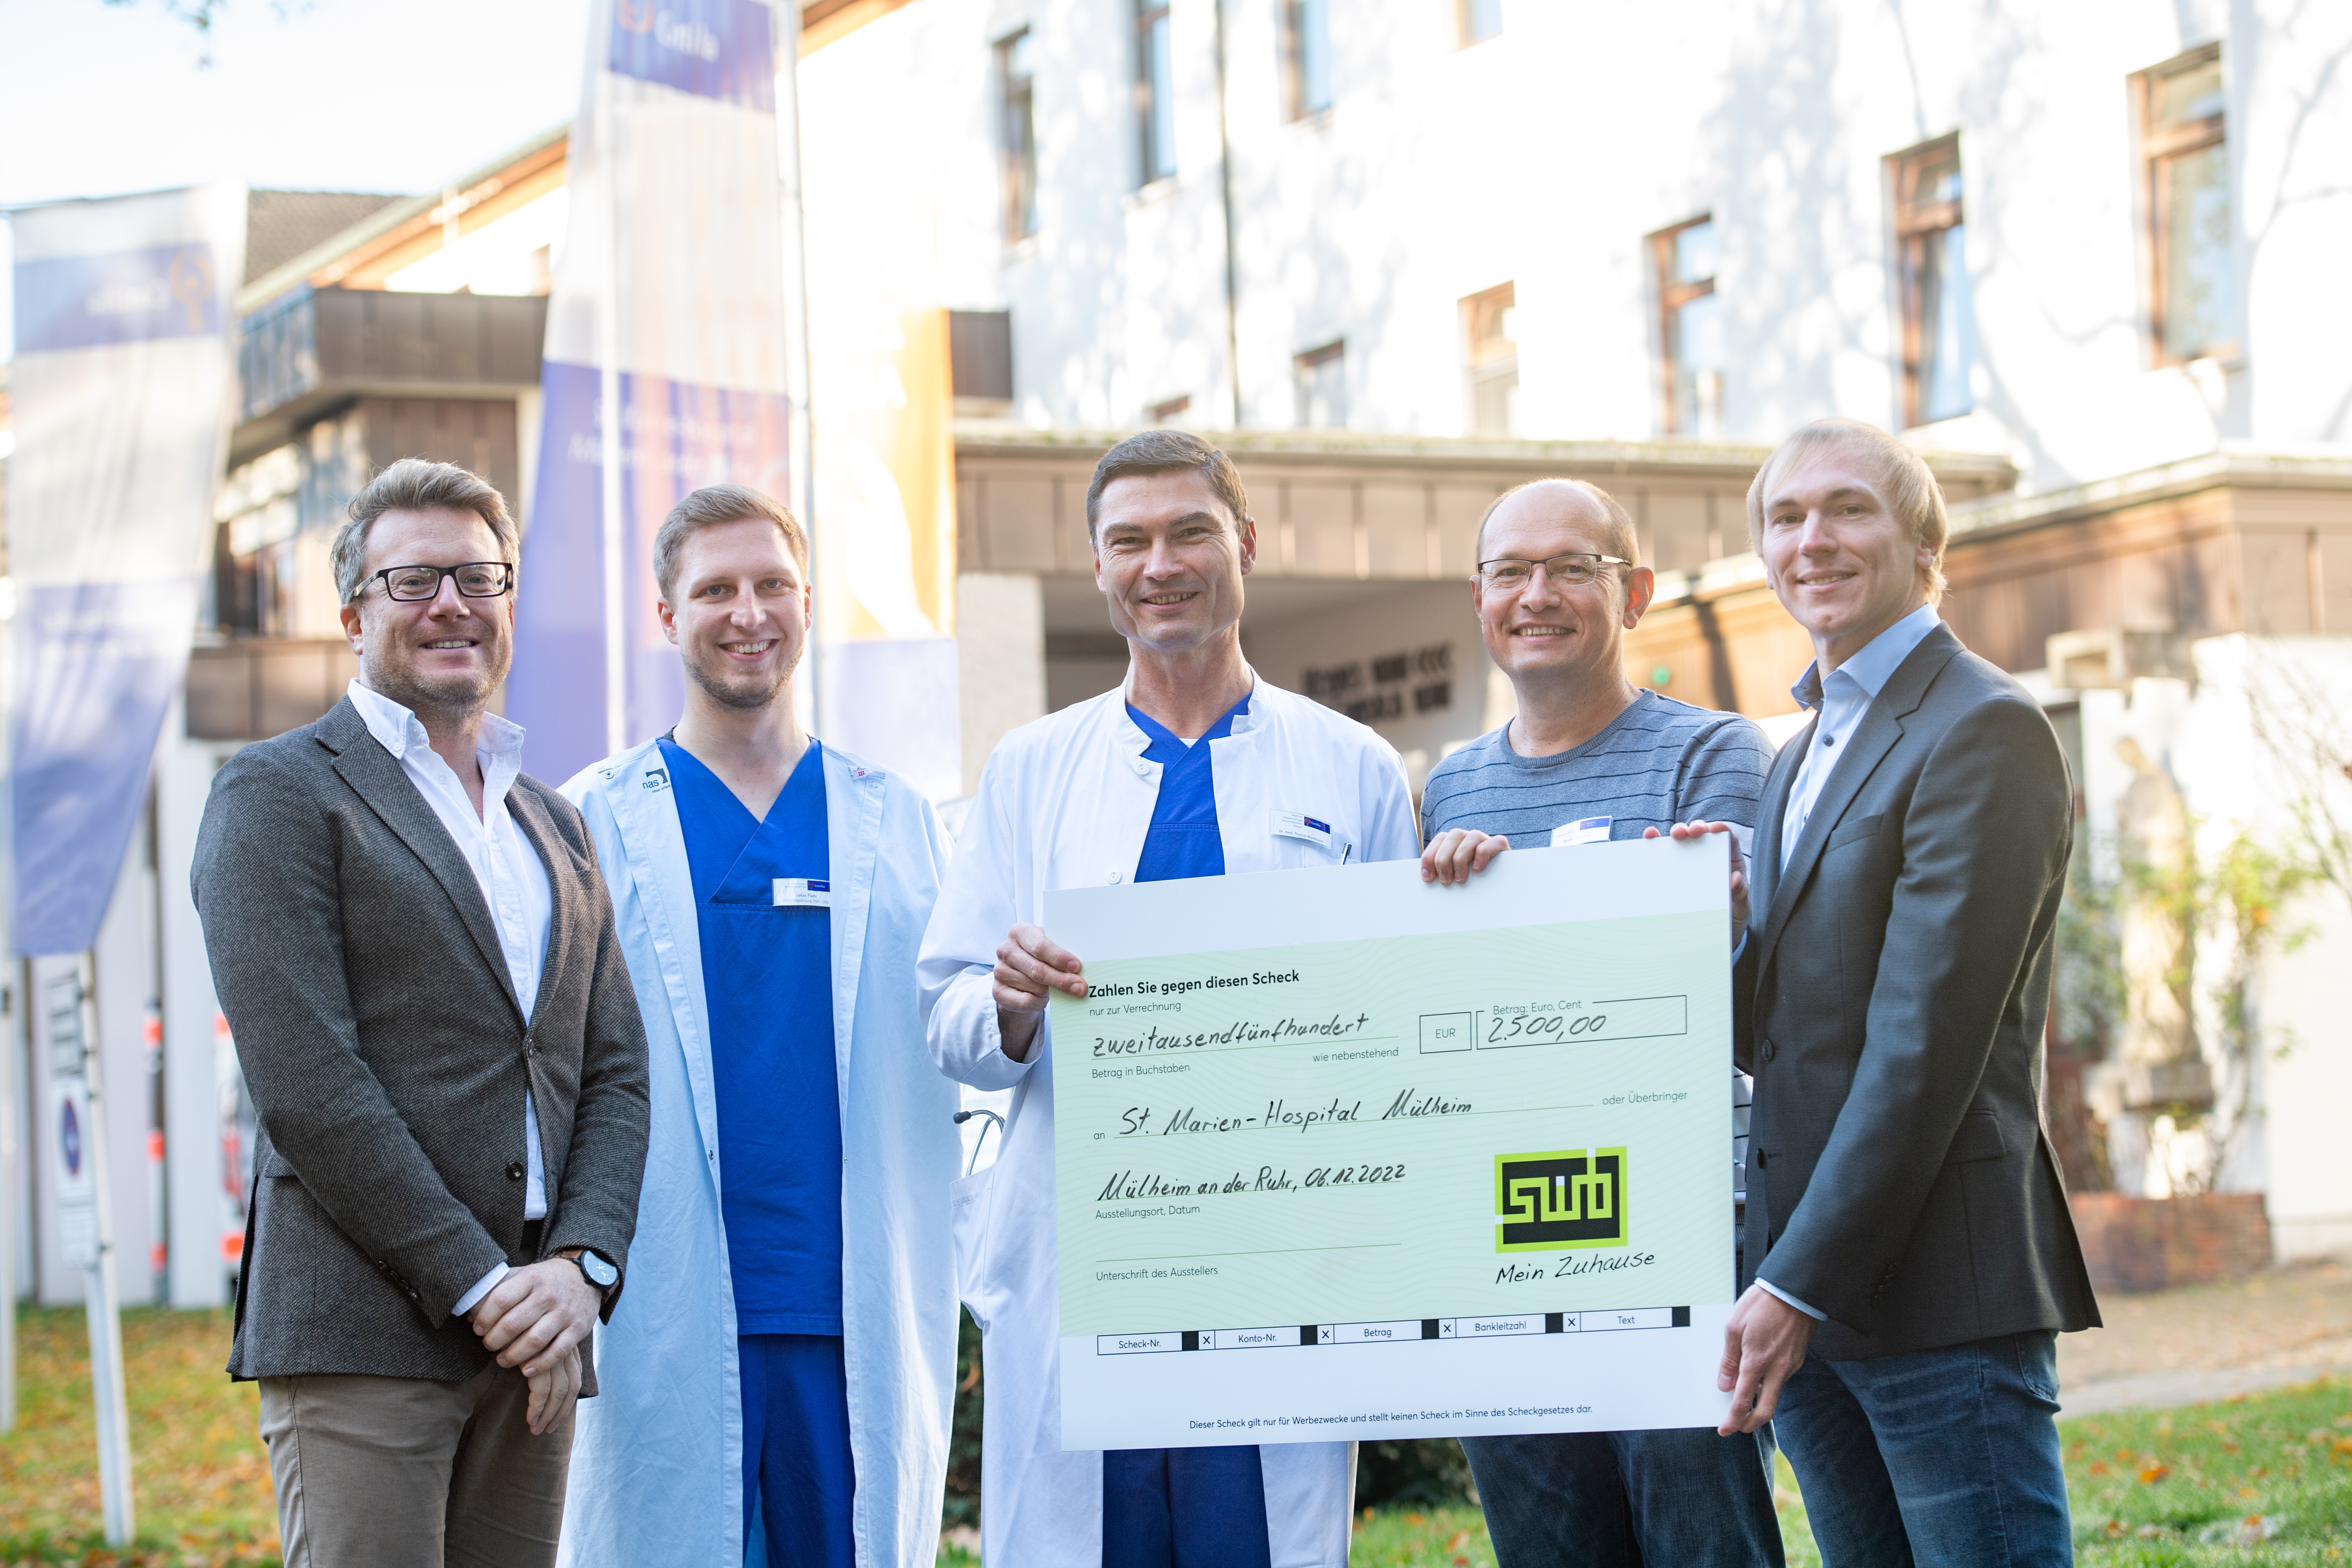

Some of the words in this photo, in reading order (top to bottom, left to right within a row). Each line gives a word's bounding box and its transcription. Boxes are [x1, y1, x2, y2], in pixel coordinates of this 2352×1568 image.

[642, 780, 659, 789] nas
[1089, 983, 1133, 998] Zahlen
[1138, 981, 1157, 994] Sie
[1161, 981, 1201, 995] gegen
[1206, 976, 1248, 988] diesen
[1252, 969, 1299, 985] Scheck
[1123, 1002, 1181, 1013] Verrechnung
[1493, 1005, 1528, 1015] Betrag:
[1531, 1002, 1555, 1012] Euro,
[1558, 1000, 1582, 1010] Cent
[1093, 1013, 1368, 1057] zweitausendfünfhundert
[1436, 1028, 1456, 1039] EUR
[1488, 1015, 1606, 1043] 2.500,00
[1332, 1047, 1398, 1061] nebenstehend
[1092, 1069, 1122, 1079] Betrag
[1125, 1067, 1133, 1076] in
[1136, 1063, 1190, 1075] Buchstaben
[1602, 1095, 1625, 1105] oder
[1628, 1091, 1688, 1103] Überbringer
[1120, 1108, 1150, 1134] St.
[1382, 1088, 1471, 1119] Mülheim
[1097, 1170, 1190, 1200] Mülheim
[1198, 1183, 1220, 1194] an
[1223, 1172, 1250, 1193] der
[1254, 1166, 1297, 1192] Ruhr,
[1305, 1165, 1405, 1187] 06.12.2022
[1095, 1207, 1165, 1219] Ausstellungsort,
[1169, 1205, 1200, 1215] Datum
[1096, 1269, 1149, 1281] Unterschrift
[1152, 1268, 1167, 1278] des
[1170, 1266, 1218, 1277] Ausstellers
[1495, 1263, 1544, 1285] Mein
[1554, 1252, 1655, 1278] Zuhause
[1475, 1321, 1526, 1331] Bankleitzahl
[1617, 1316, 1635, 1324] Text
[1239, 1334, 1277, 1343] Konto-Nr.
[1364, 1328, 1391, 1338] Betrag
[1118, 1339, 1162, 1349] Scheck-Nr.
[1190, 1421, 1215, 1429] Dieser
[1217, 1418, 1246, 1428] Scheck
[1248, 1418, 1261, 1429] gilt
[1279, 1417, 1290, 1425] für
[1292, 1415, 1348, 1425] Werbezwecke
[1351, 1413, 1366, 1422] und
[1369, 1413, 1388, 1422] stellt
[1391, 1413, 1418, 1421] keinen
[1421, 1410, 1450, 1420] Scheck
[1452, 1410, 1463, 1418] im
[1465, 1409, 1488, 1418] Sinne
[1491, 1408, 1505, 1417] des
[1508, 1406, 1574, 1417] Scheckgesetzes
[1576, 1405, 1592, 1413] dar.
